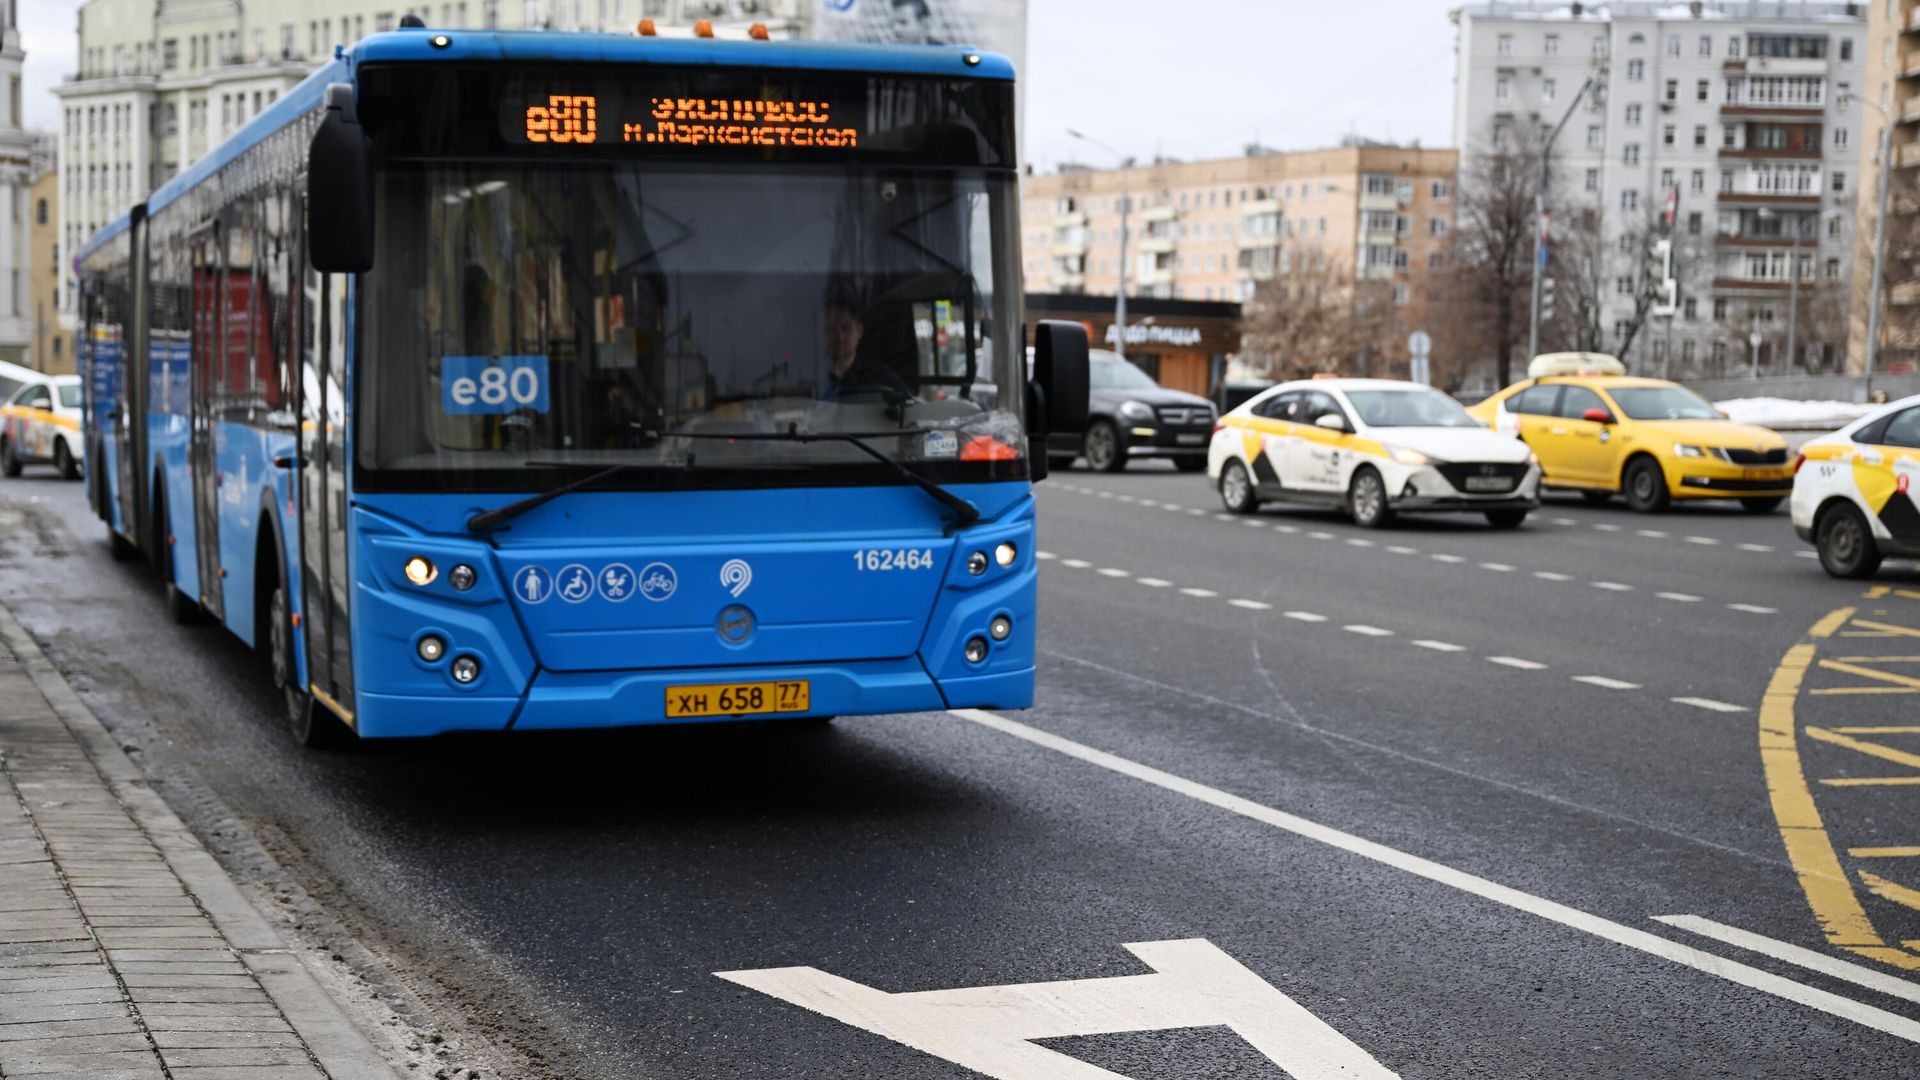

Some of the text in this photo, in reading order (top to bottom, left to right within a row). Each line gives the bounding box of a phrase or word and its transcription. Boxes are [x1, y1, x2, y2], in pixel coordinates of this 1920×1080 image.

[853, 549, 934, 571] 162464
[719, 686, 764, 710] 658
[779, 682, 801, 701] 77
